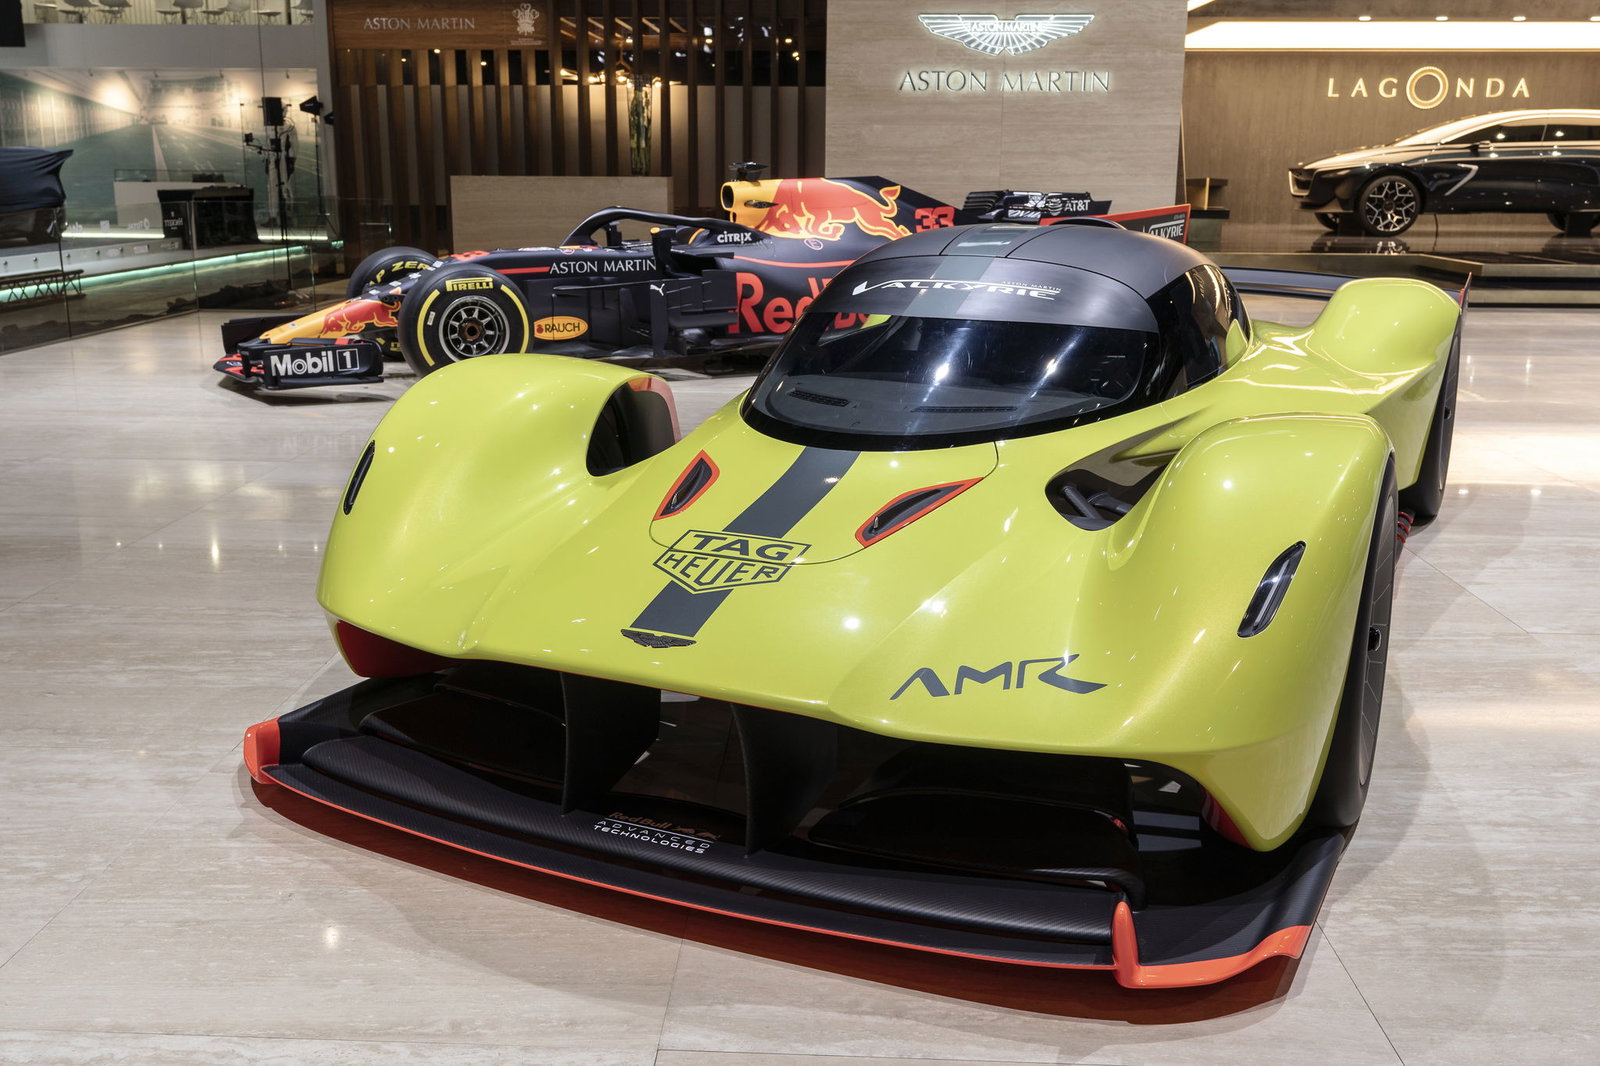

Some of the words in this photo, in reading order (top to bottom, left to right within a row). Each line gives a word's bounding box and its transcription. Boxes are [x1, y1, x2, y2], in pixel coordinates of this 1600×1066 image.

[363, 17, 411, 30] ASTON
[416, 17, 476, 30] MARTIN
[972, 21, 1003, 32] ASTON
[1004, 21, 1042, 32] MARTIN
[898, 70, 988, 92] ASTON
[1001, 71, 1110, 92] MARTIN
[1327, 66, 1530, 109] LAGONDA
[1063, 199, 1091, 212] AT&T
[914, 206, 956, 233] 33
[391, 261, 430, 272] ZER
[550, 260, 598, 275] ASTON
[603, 259, 657, 272] MARTIN
[445, 277, 495, 292] PIRELLI
[852, 279, 1061, 301] VALKYRIE
[544, 322, 581, 333] RAUCH
[270, 350, 335, 377] Mobil
[692, 533, 795, 562] TAG
[663, 553, 780, 587] HEUER
[888, 653, 1109, 701] AMR
[593, 824, 706, 854] TECHNOLOGIES
[596, 820, 711, 849] ADVANCED
